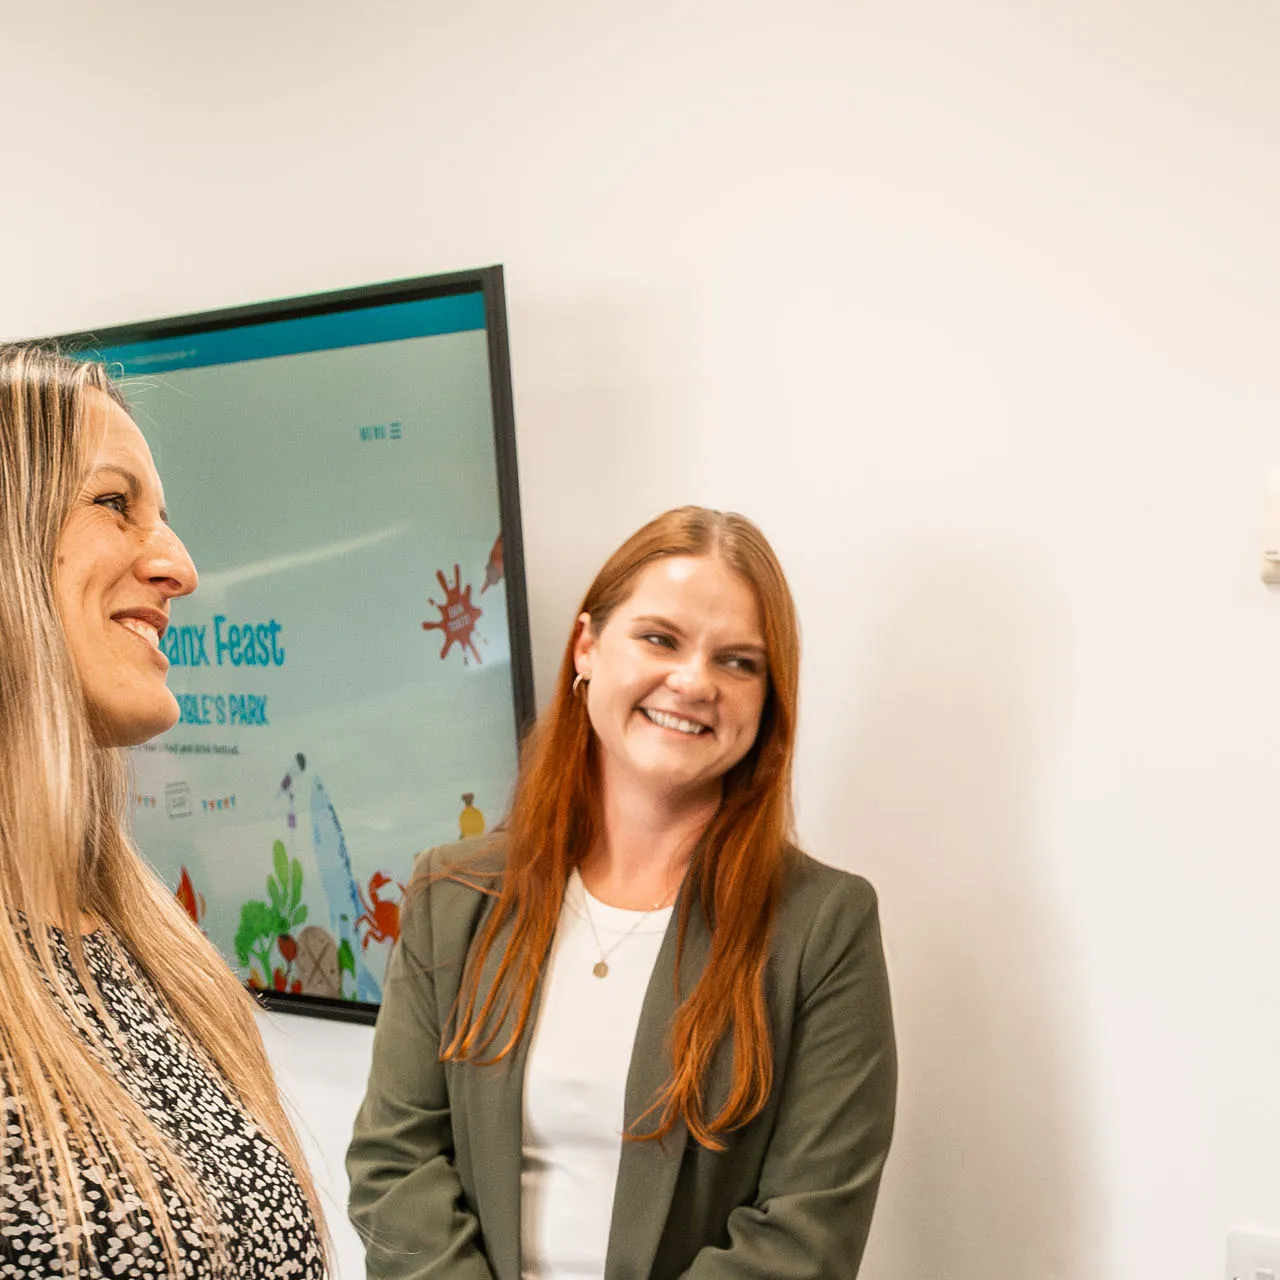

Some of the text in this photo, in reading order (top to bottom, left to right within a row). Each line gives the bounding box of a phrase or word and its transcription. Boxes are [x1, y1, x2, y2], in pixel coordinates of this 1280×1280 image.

[159, 613, 286, 668] anx Feast
[228, 692, 270, 726] PARK
